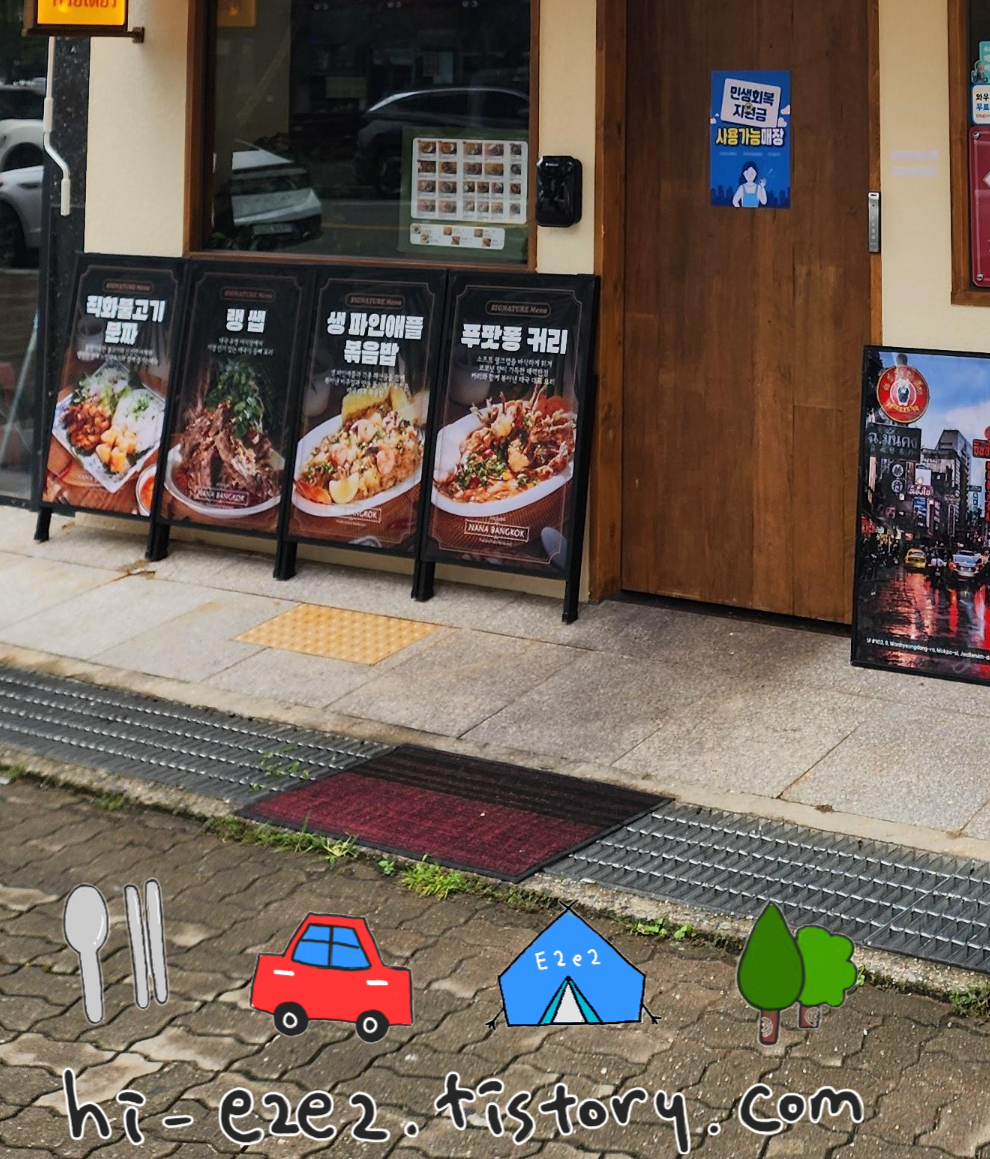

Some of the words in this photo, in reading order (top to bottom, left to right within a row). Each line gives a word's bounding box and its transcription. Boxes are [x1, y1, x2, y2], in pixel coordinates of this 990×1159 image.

[730, 85, 775, 106] 민생회복
[733, 104, 767, 122] 지원금
[86, 295, 166, 323] 직화불고기
[327, 311, 346, 335] 생
[348, 312, 424, 340] 파인애플
[461, 323, 523, 352] 푸팟퐁
[526, 327, 568, 355] 커리
[344, 339, 400, 367] 볶음밥
[490, 525, 526, 539] BANGKOK
